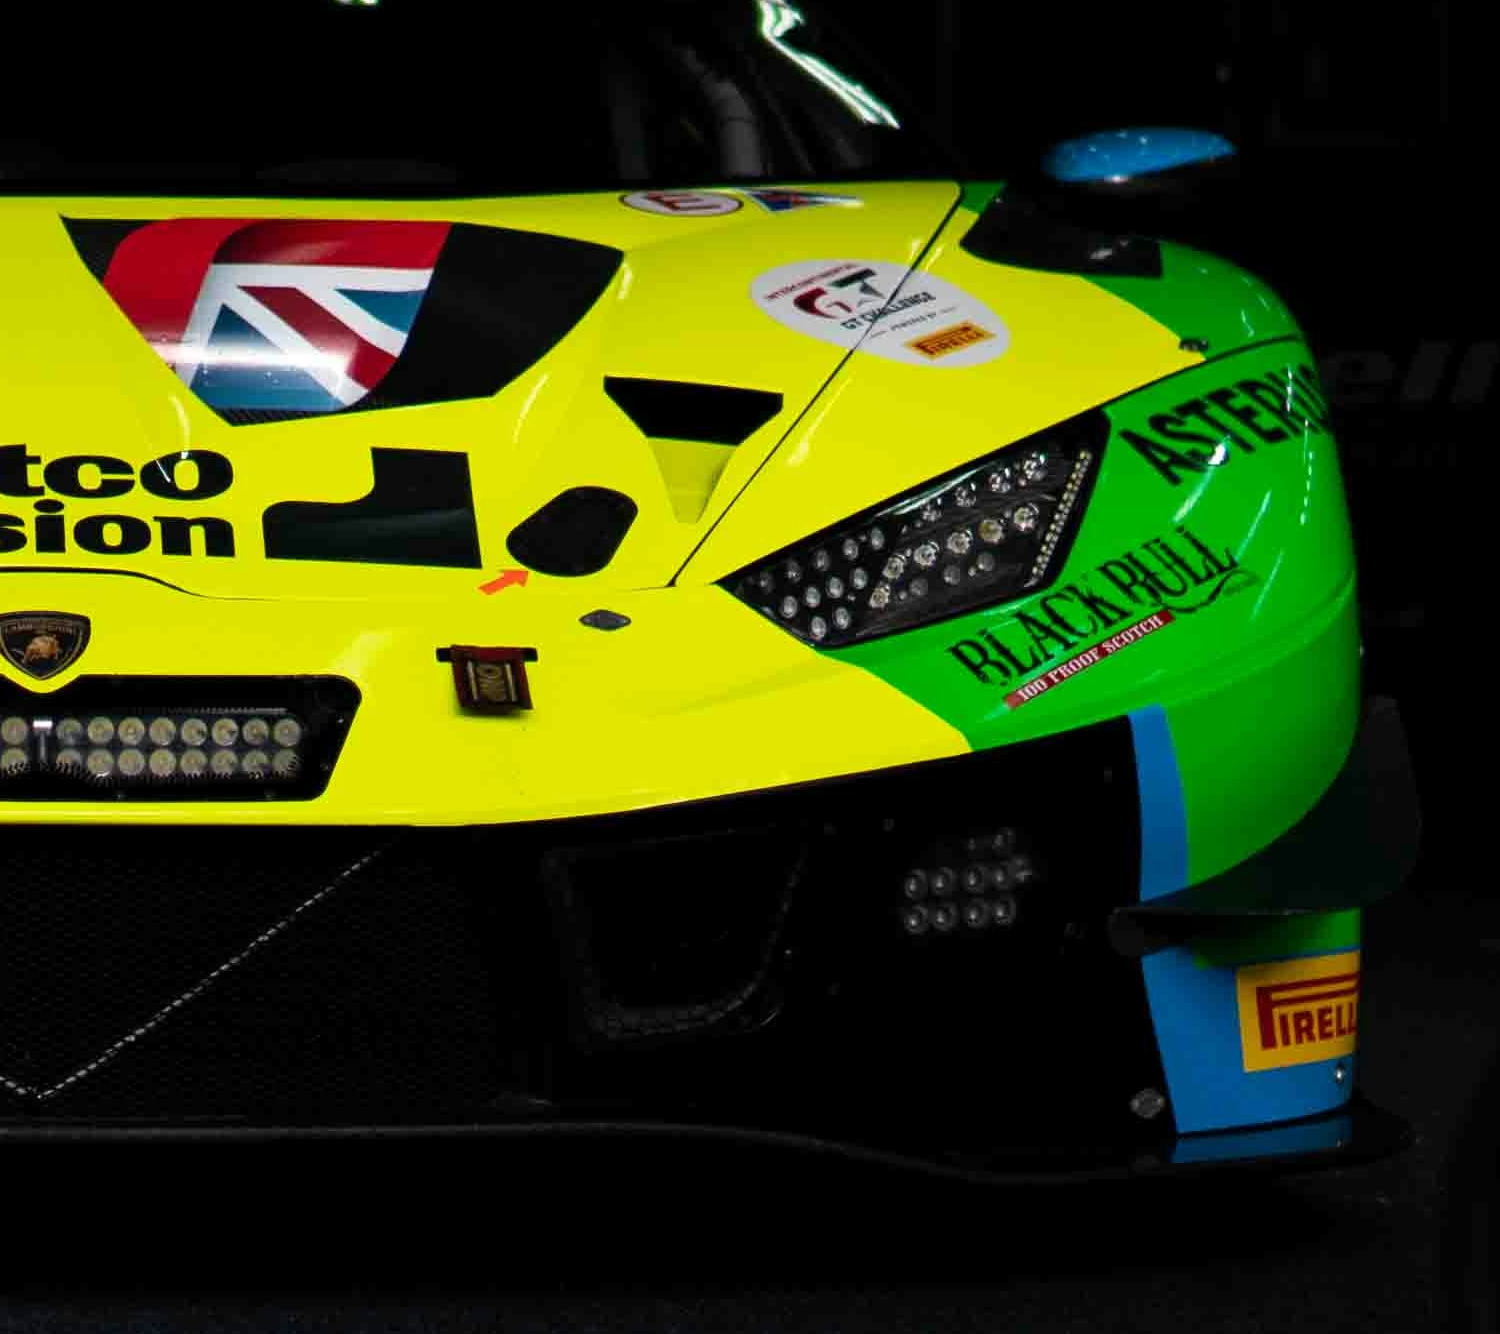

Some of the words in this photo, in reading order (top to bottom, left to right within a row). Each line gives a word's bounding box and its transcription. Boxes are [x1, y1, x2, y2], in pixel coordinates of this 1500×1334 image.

[1118, 363, 1328, 487] ASTERU
[945, 580, 1134, 686] BLACK
[1095, 525, 1241, 608] BULL
[1016, 678, 1050, 703] 100
[1047, 650, 1103, 685] PROOF
[1101, 612, 1165, 656] SCOTCH
[1256, 970, 1363, 1051] PIRELL
